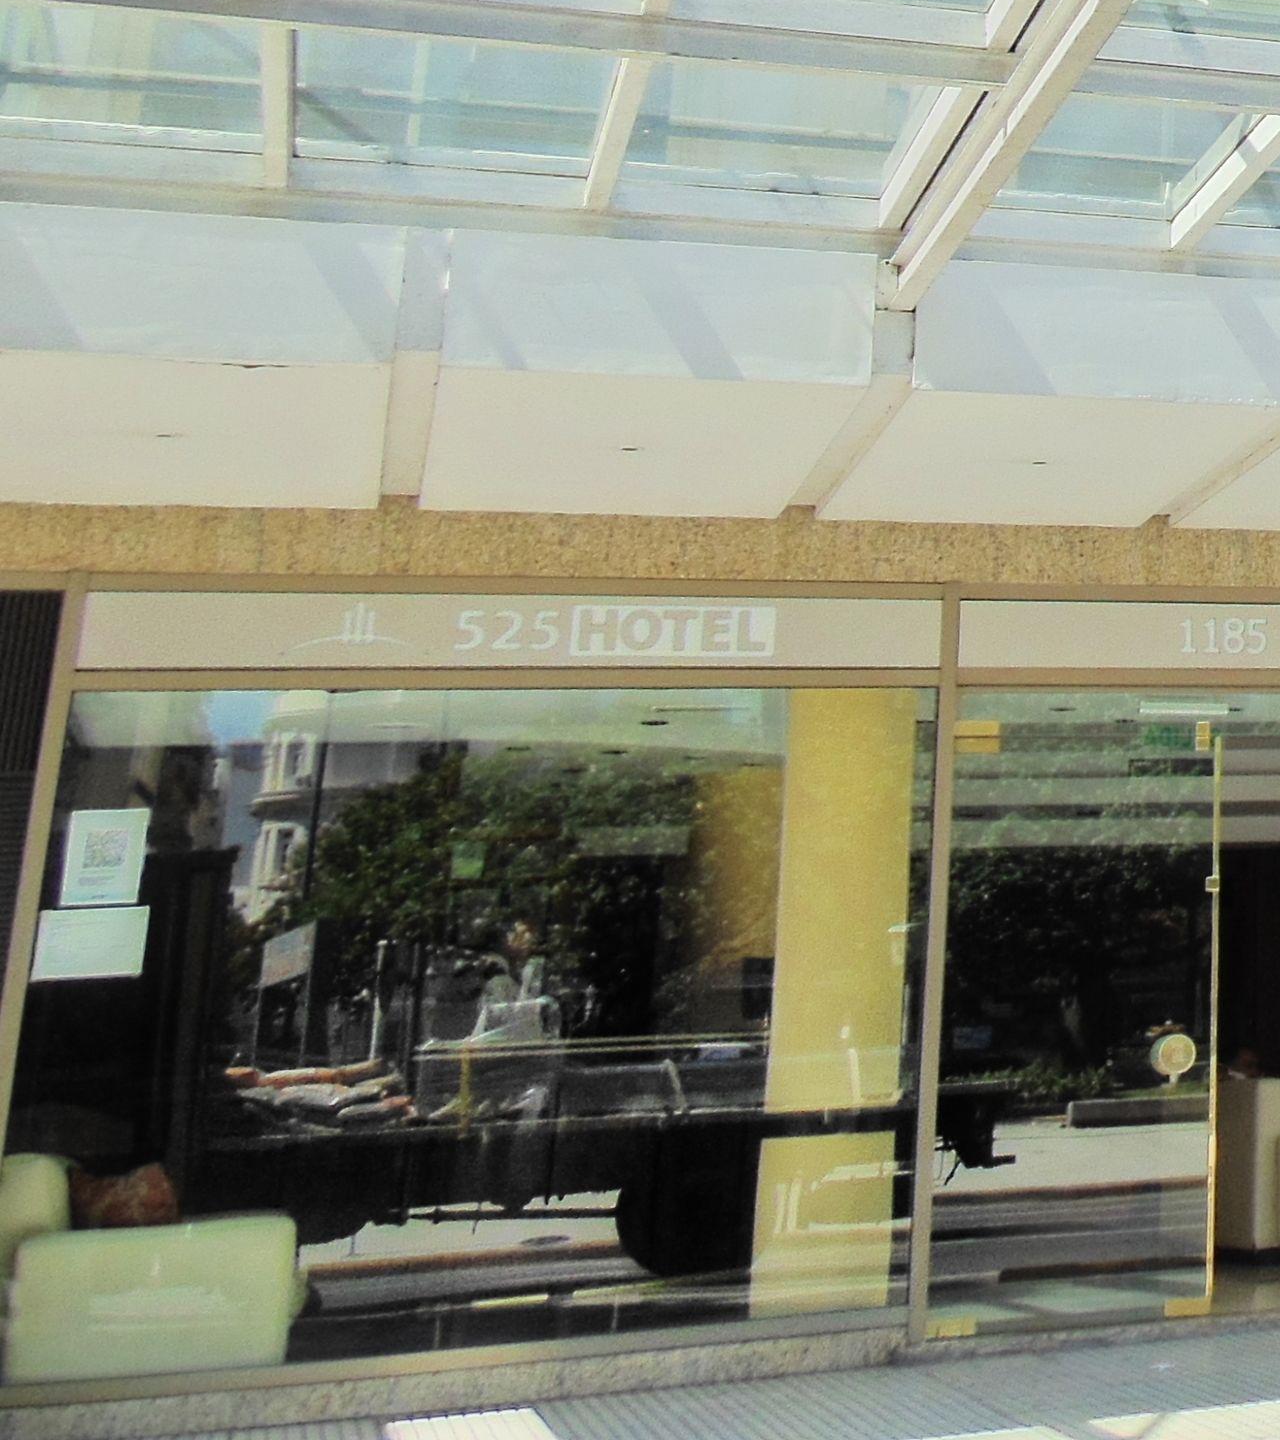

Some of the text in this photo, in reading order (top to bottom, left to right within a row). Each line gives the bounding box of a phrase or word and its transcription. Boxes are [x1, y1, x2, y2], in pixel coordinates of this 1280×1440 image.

[453, 606, 771, 655] 525 HOTEL
[1179, 617, 1269, 656] 1185
